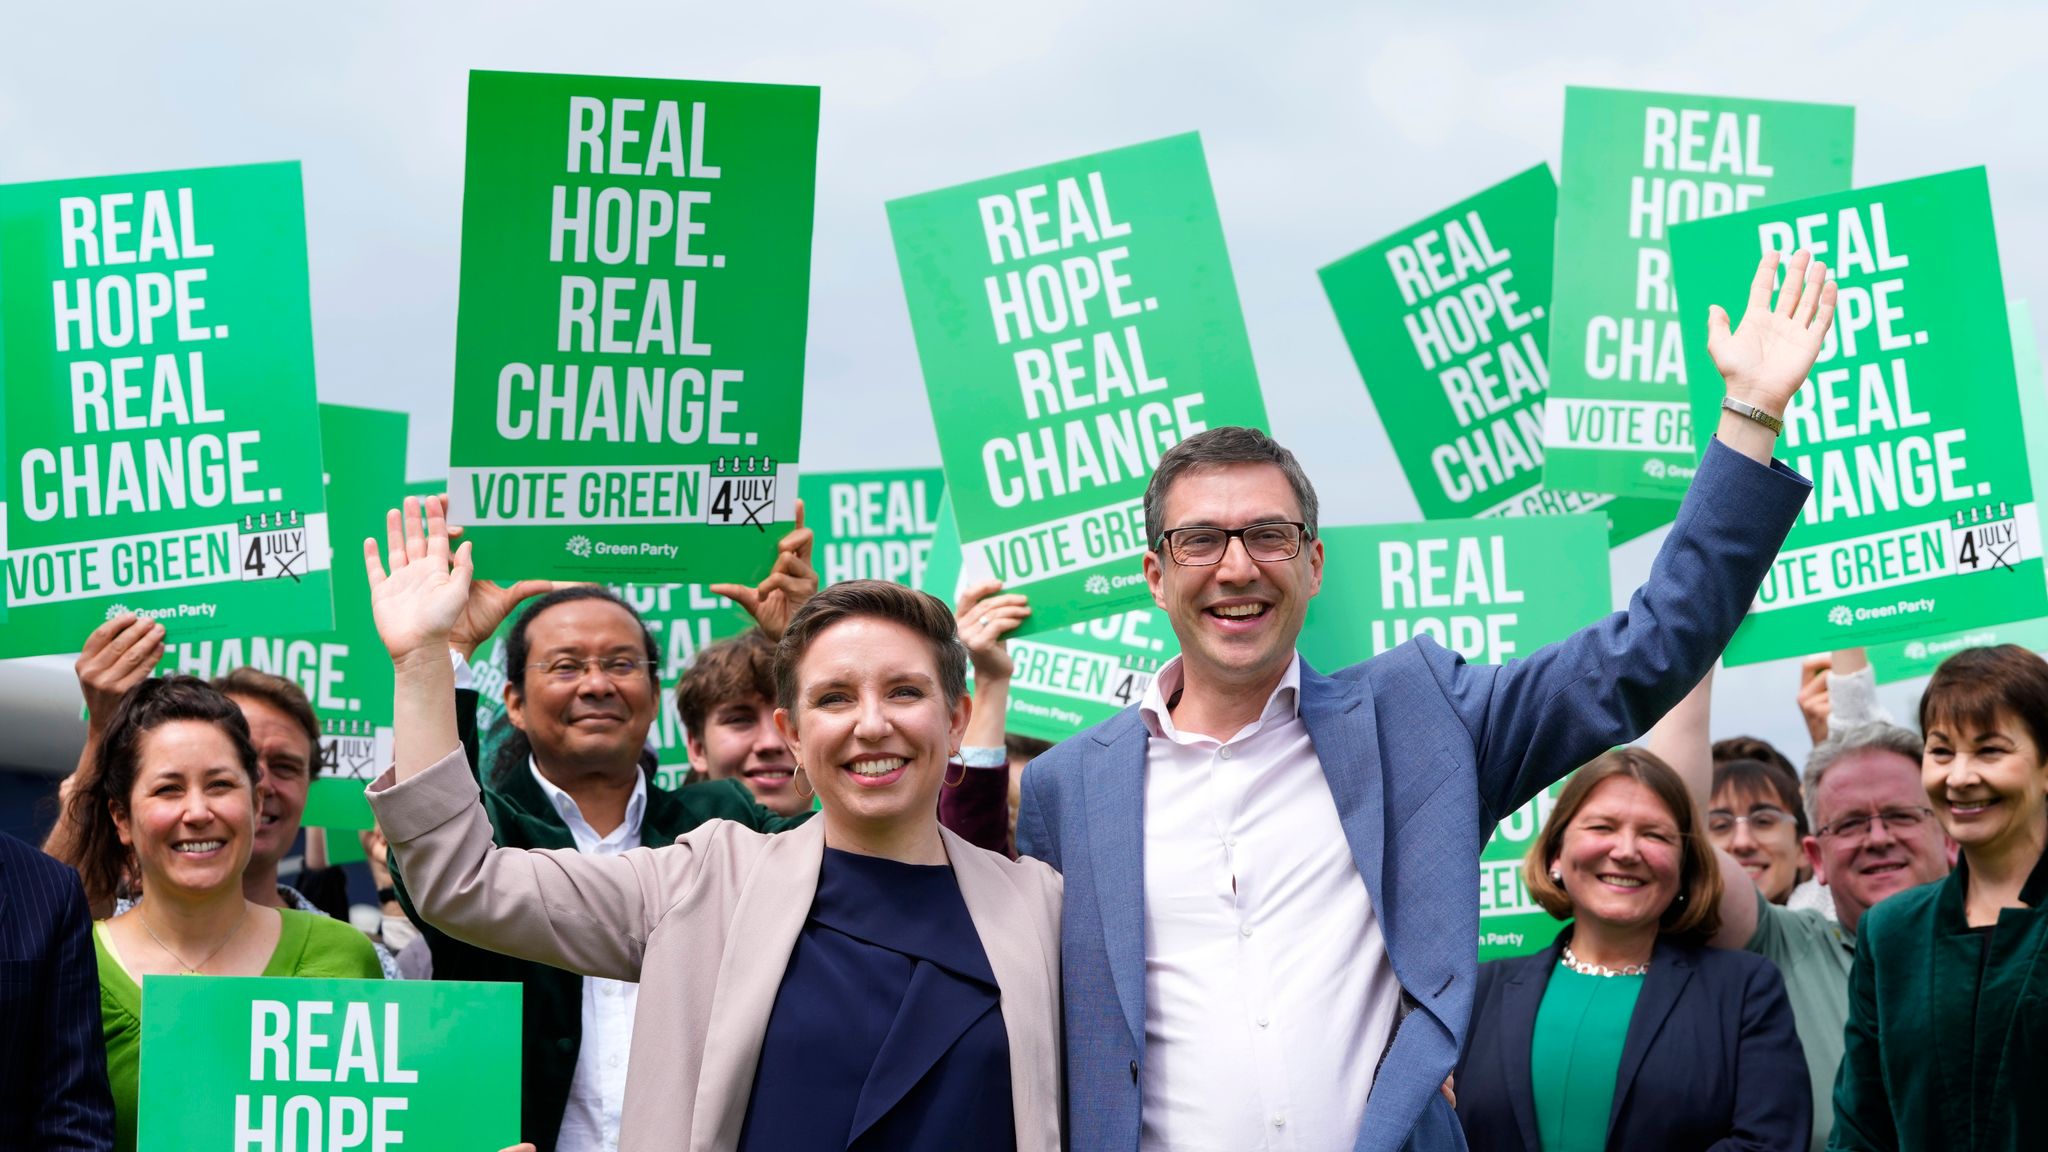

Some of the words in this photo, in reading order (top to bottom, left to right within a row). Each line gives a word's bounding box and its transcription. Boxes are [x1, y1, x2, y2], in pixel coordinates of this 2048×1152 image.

[566, 95, 720, 179] REAL
[1643, 106, 1774, 178] REAL
[59, 187, 214, 268] REAL
[549, 185, 726, 269] HOPE.
[978, 171, 1132, 265] REAL
[984, 246, 1159, 345] HOPE.
[1384, 210, 1512, 307] REAL
[52, 268, 229, 351] HOPE.
[557, 274, 712, 356] REAL
[1403, 267, 1545, 371] HOPE.
[69, 351, 224, 433] REAL
[496, 362, 758, 446] CHANGE.
[1013, 325, 1168, 420] REAL
[1782, 358, 1931, 448] REAL
[1565, 404, 1643, 444] VOTE
[19, 430, 282, 522] CHANGE.
[471, 472, 567, 519] VOTE
[578, 470, 699, 519] GREEN
[711, 479, 733, 523] 4
[734, 478, 774, 502] JULY
[830, 479, 937, 538] REAL
[8, 547, 101, 600] VOTE
[111, 530, 232, 587] GREEN
[244, 536, 266, 577] 4
[264, 531, 303, 556] JULY
[595, 541, 638, 555] Green
[640, 542, 679, 559] Party
[983, 523, 1077, 582] VOTE
[1081, 504, 1147, 559] GRE
[1379, 535, 1525, 609] REAL
[1759, 553, 1822, 604] OTE
[1830, 528, 1946, 589] GREEN
[1959, 531, 1980, 569] 4
[1978, 523, 2014, 549] JULY
[134, 606, 177, 620] Green
[178, 602, 218, 618] Party
[1855, 602, 1897, 621] Green
[1898, 597, 1936, 614] Party
[1010, 645, 1109, 696] GREEN
[1114, 673, 1134, 704] 4
[320, 739, 339, 774] 4
[340, 740, 373, 758] JULY
[1487, 932, 1525, 947] Party
[250, 1000, 418, 1083] REAL
